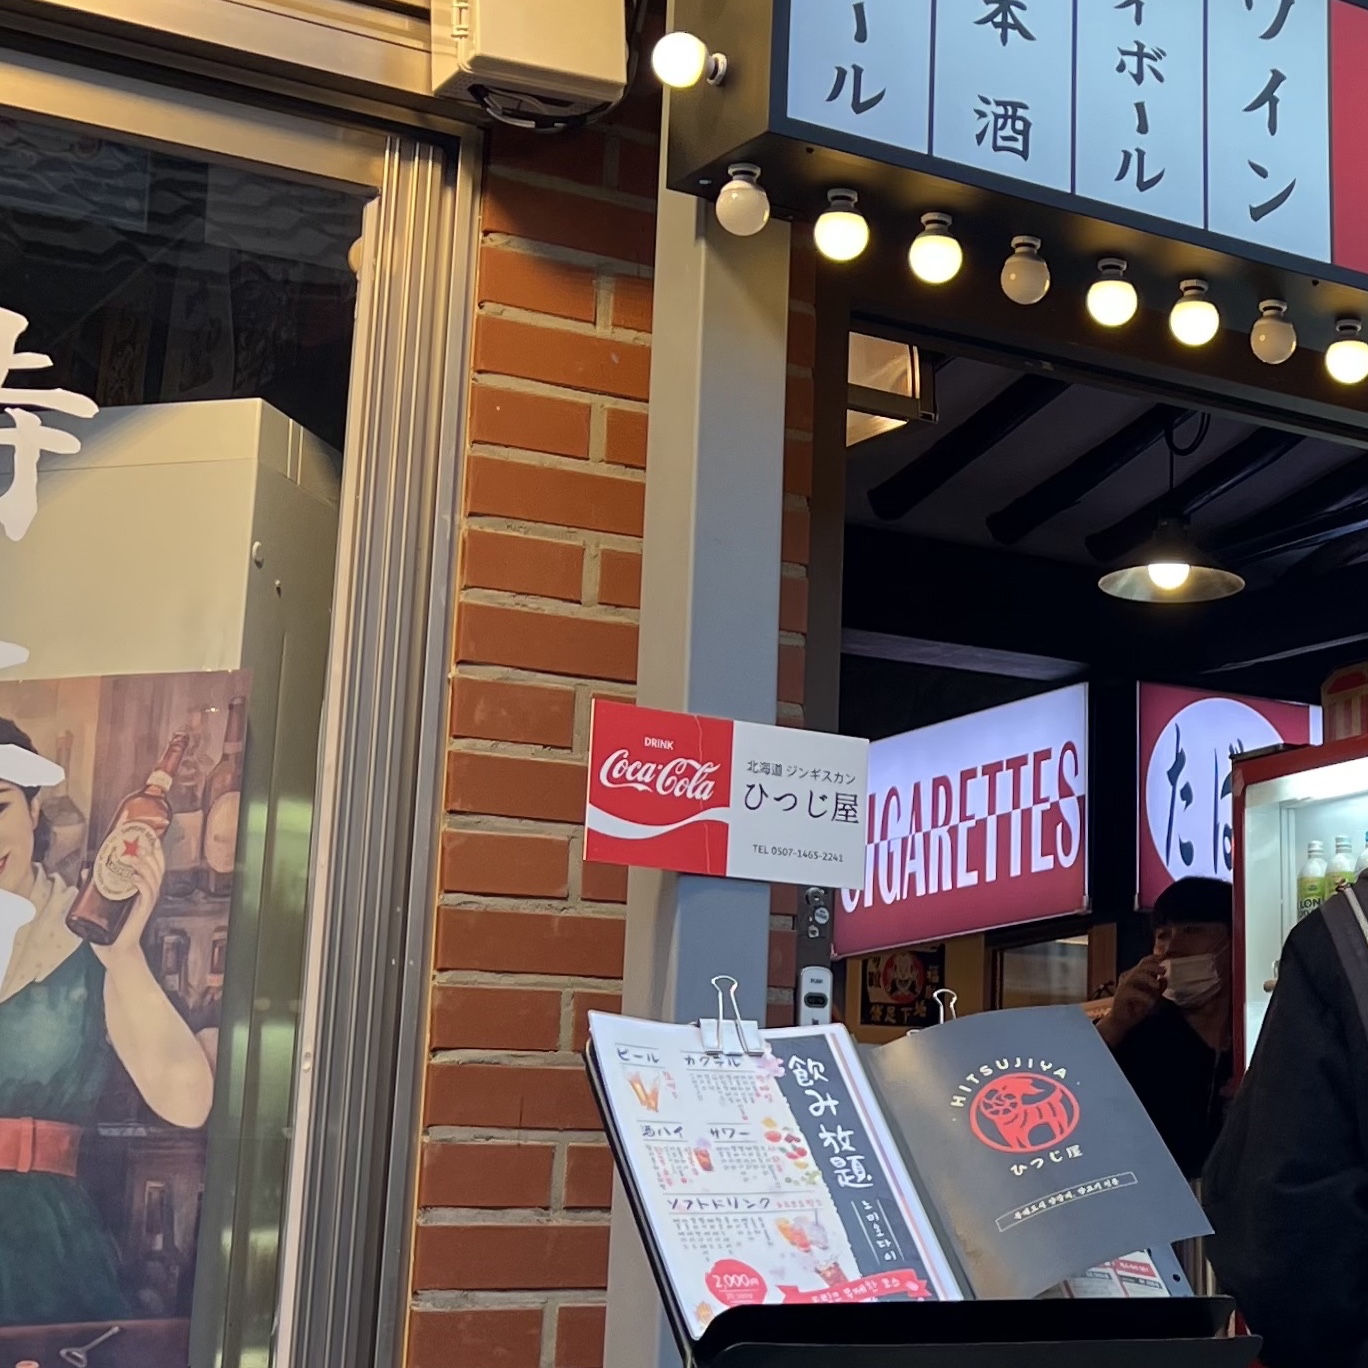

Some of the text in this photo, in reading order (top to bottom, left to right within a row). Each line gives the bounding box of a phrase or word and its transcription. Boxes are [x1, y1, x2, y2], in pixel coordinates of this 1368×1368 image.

[644, 736, 674, 750] DRINK
[600, 749, 721, 801] Coca-Cola
[786, 764, 856, 785] ジンギスカン
[744, 783, 859, 824] ひつじ屋
[752, 844, 844, 862] TEL 0507-1465-2241
[617, 1047, 660, 1063] ビール
[950, 1057, 1068, 1108] HITSUJIYA
[788, 1055, 873, 1189] 飲み放題
[1010, 1145, 1083, 1176] ひつじ屋
[667, 1197, 770, 1210] ソフトドリンク
